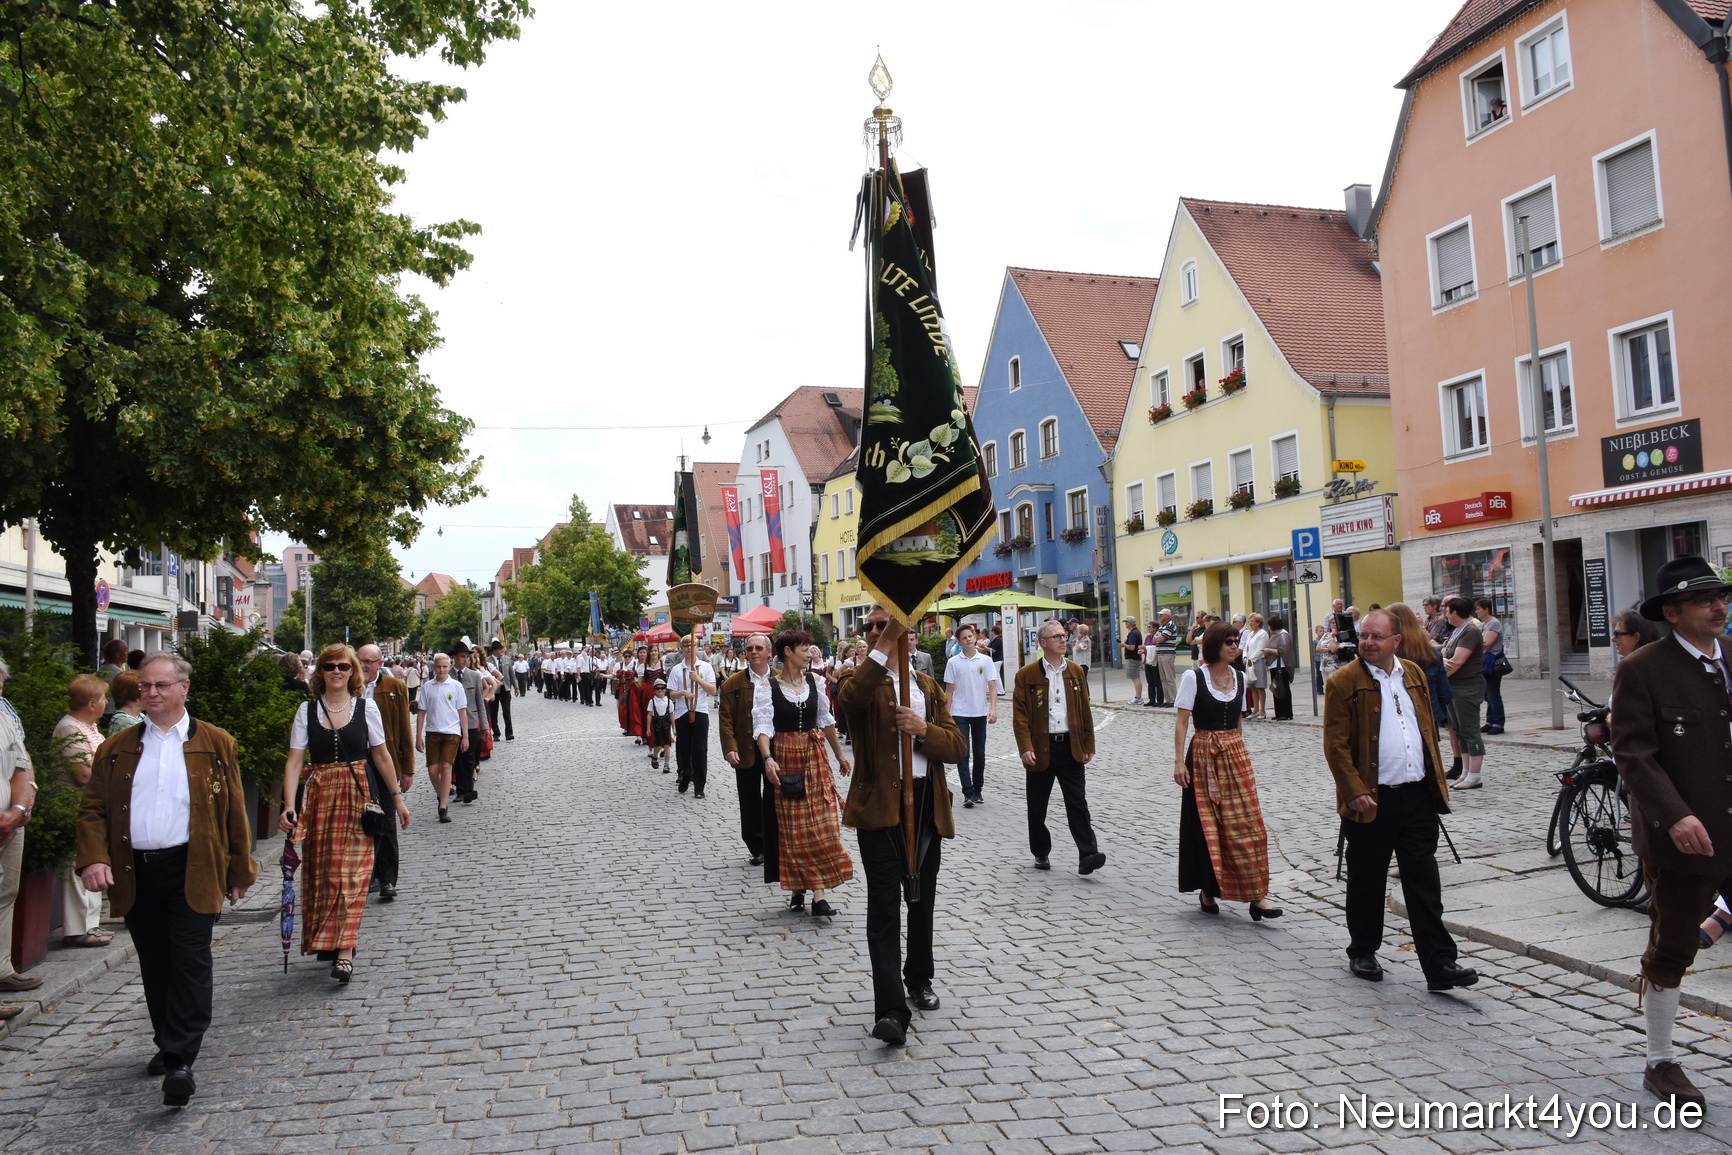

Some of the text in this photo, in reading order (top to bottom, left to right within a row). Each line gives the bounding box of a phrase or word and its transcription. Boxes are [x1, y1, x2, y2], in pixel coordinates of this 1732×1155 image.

[1609, 424, 1691, 451] NIEßLBECK
[1339, 462, 1353, 470] KINO
[1619, 465, 1684, 481] OBST & GEMÜSE
[763, 473, 773, 497] K&L
[1464, 501, 1482, 510] Deutsch
[1489, 496, 1507, 508] DER
[1384, 496, 1394, 545] KINO
[1425, 511, 1442, 525] DER
[1553, 519, 1558, 528] 15
[1331, 519, 1373, 535] RIALTO KINO
[840, 530, 855, 544] HOTEL
[1298, 532, 1314, 557] P
[965, 571, 1013, 592] APOTHEKE
[235, 595, 250, 605] H&M
[841, 593, 862, 602] Restaurant
